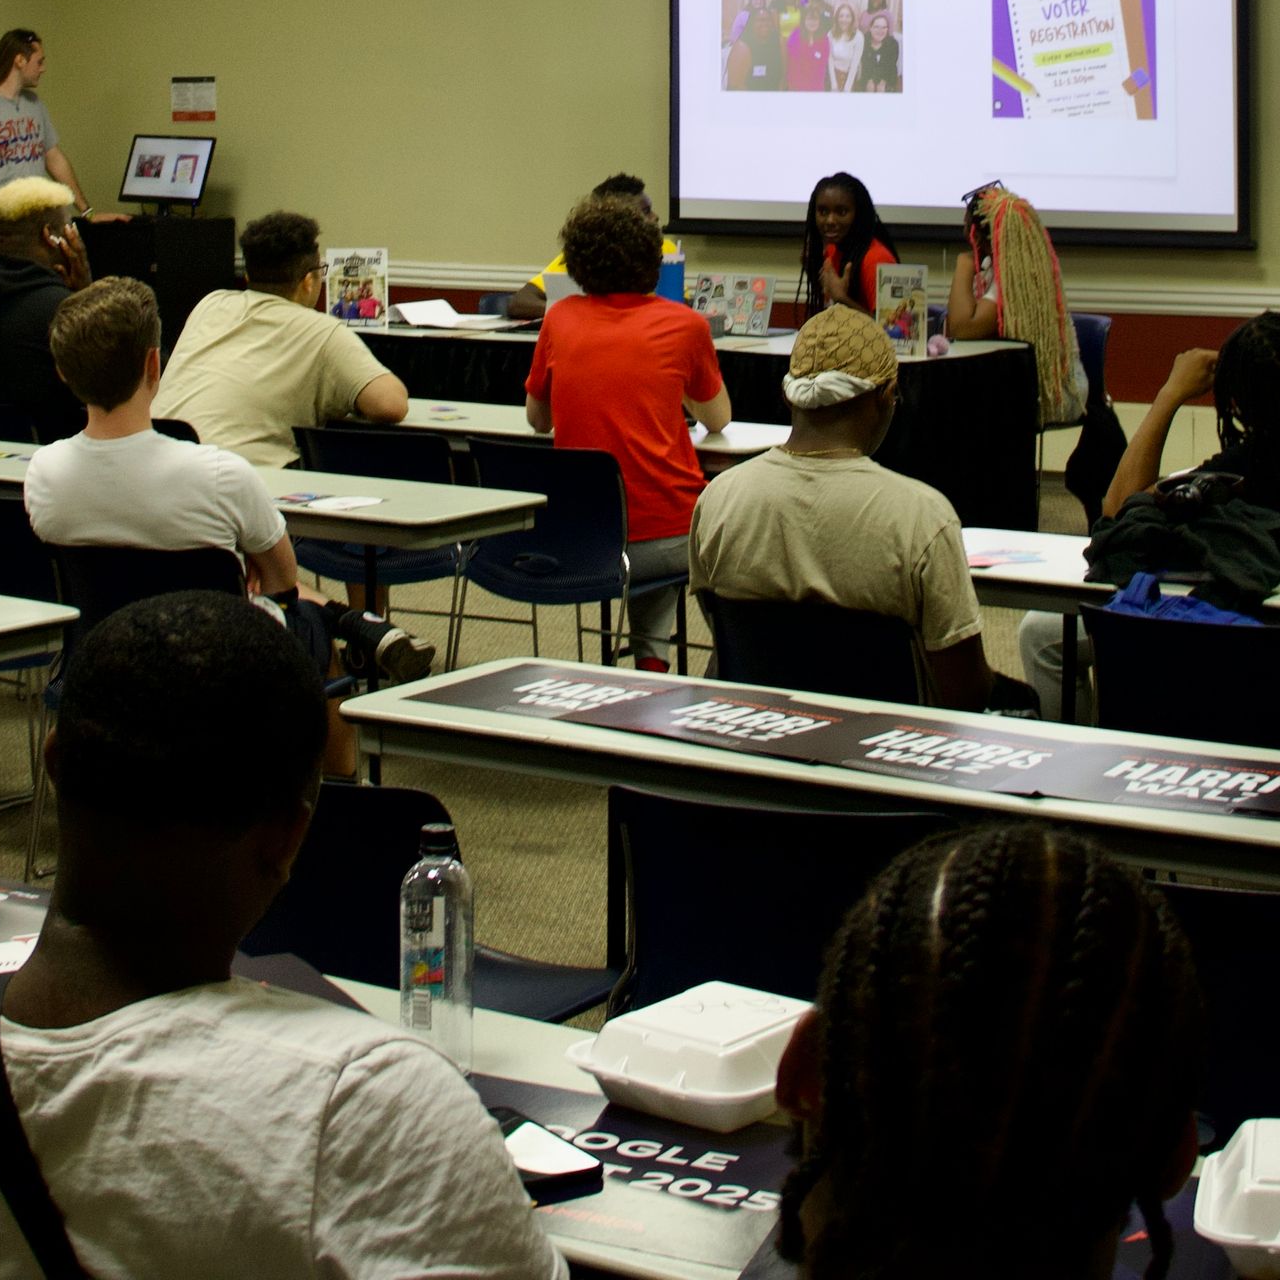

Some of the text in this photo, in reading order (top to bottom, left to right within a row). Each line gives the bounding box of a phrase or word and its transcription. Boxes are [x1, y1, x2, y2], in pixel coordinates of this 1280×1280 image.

[1029, 17, 1115, 47] REGISTRATION
[670, 700, 831, 735] HARRI
[858, 729, 1053, 770] HARRIS
[865, 747, 995, 774] WALZ
[629, 1171, 782, 1211] 2025
